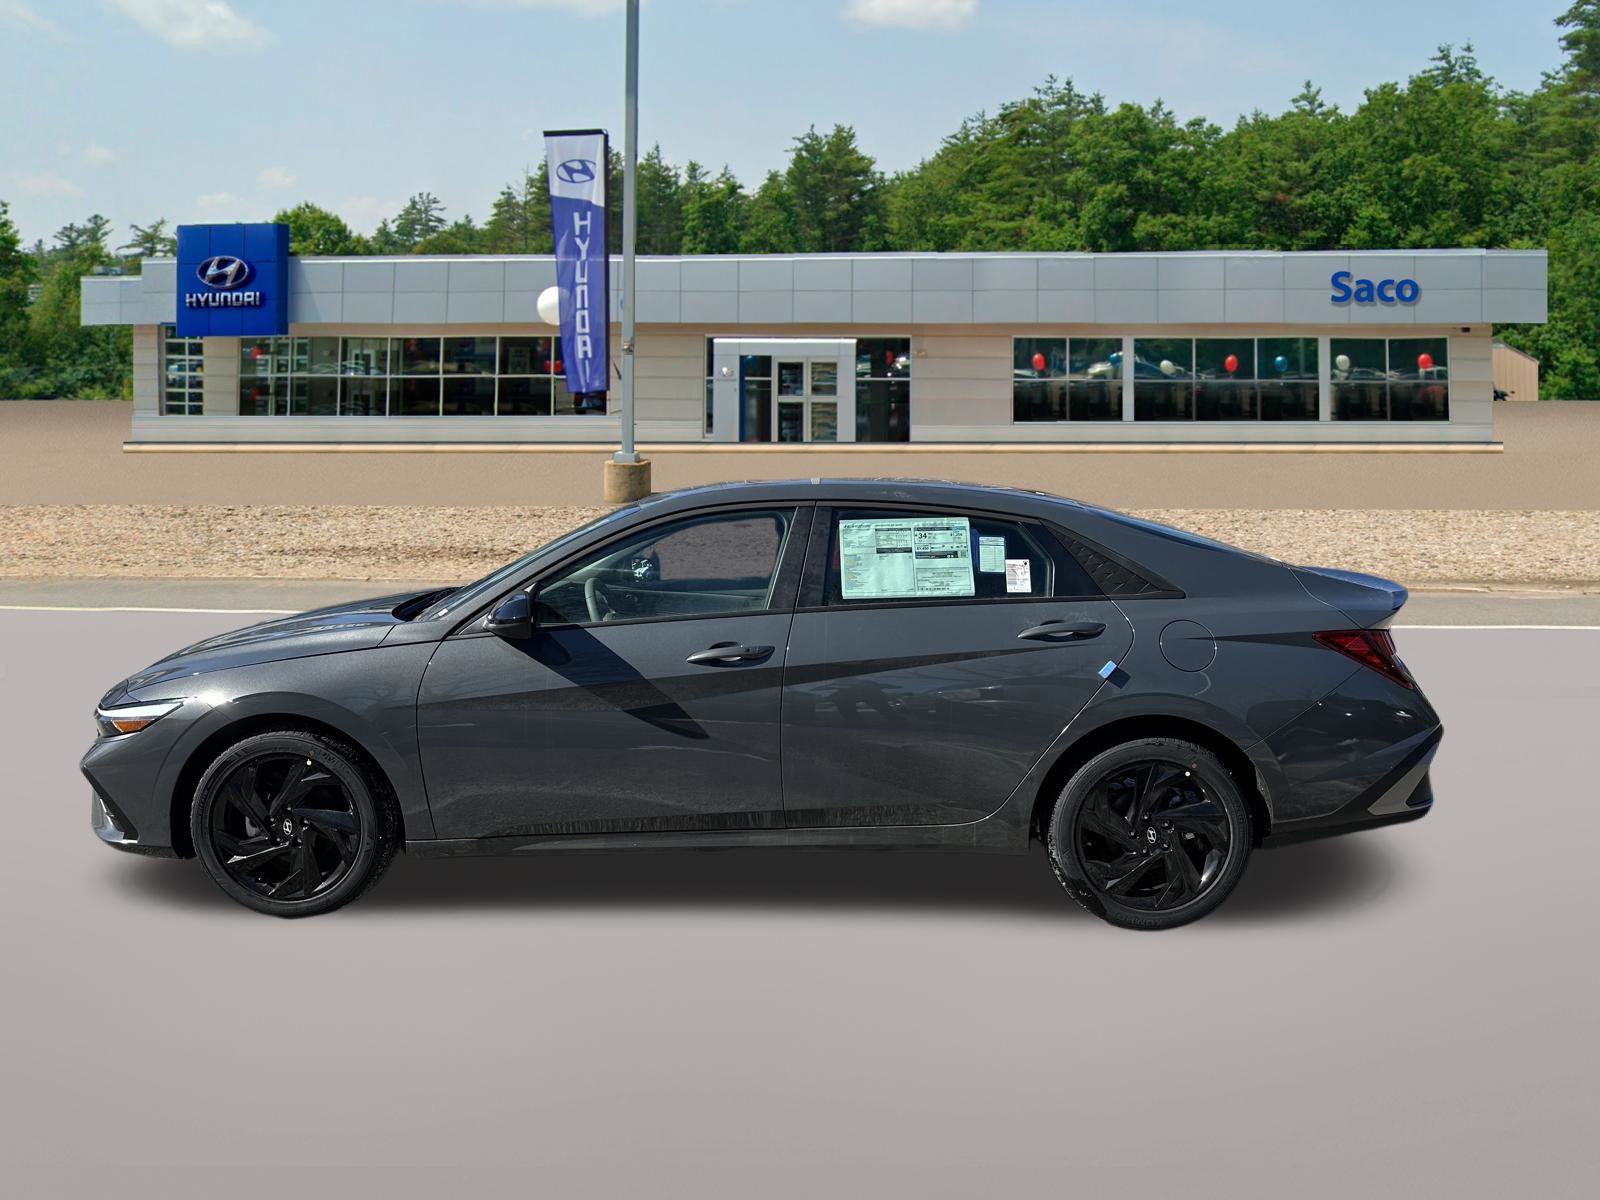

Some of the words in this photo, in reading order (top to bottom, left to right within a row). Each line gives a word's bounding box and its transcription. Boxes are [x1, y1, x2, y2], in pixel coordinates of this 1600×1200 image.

[185, 291, 260, 307] HYUNDAI
[573, 211, 592, 383] HYUNDAI
[1331, 271, 1419, 303] Saco
